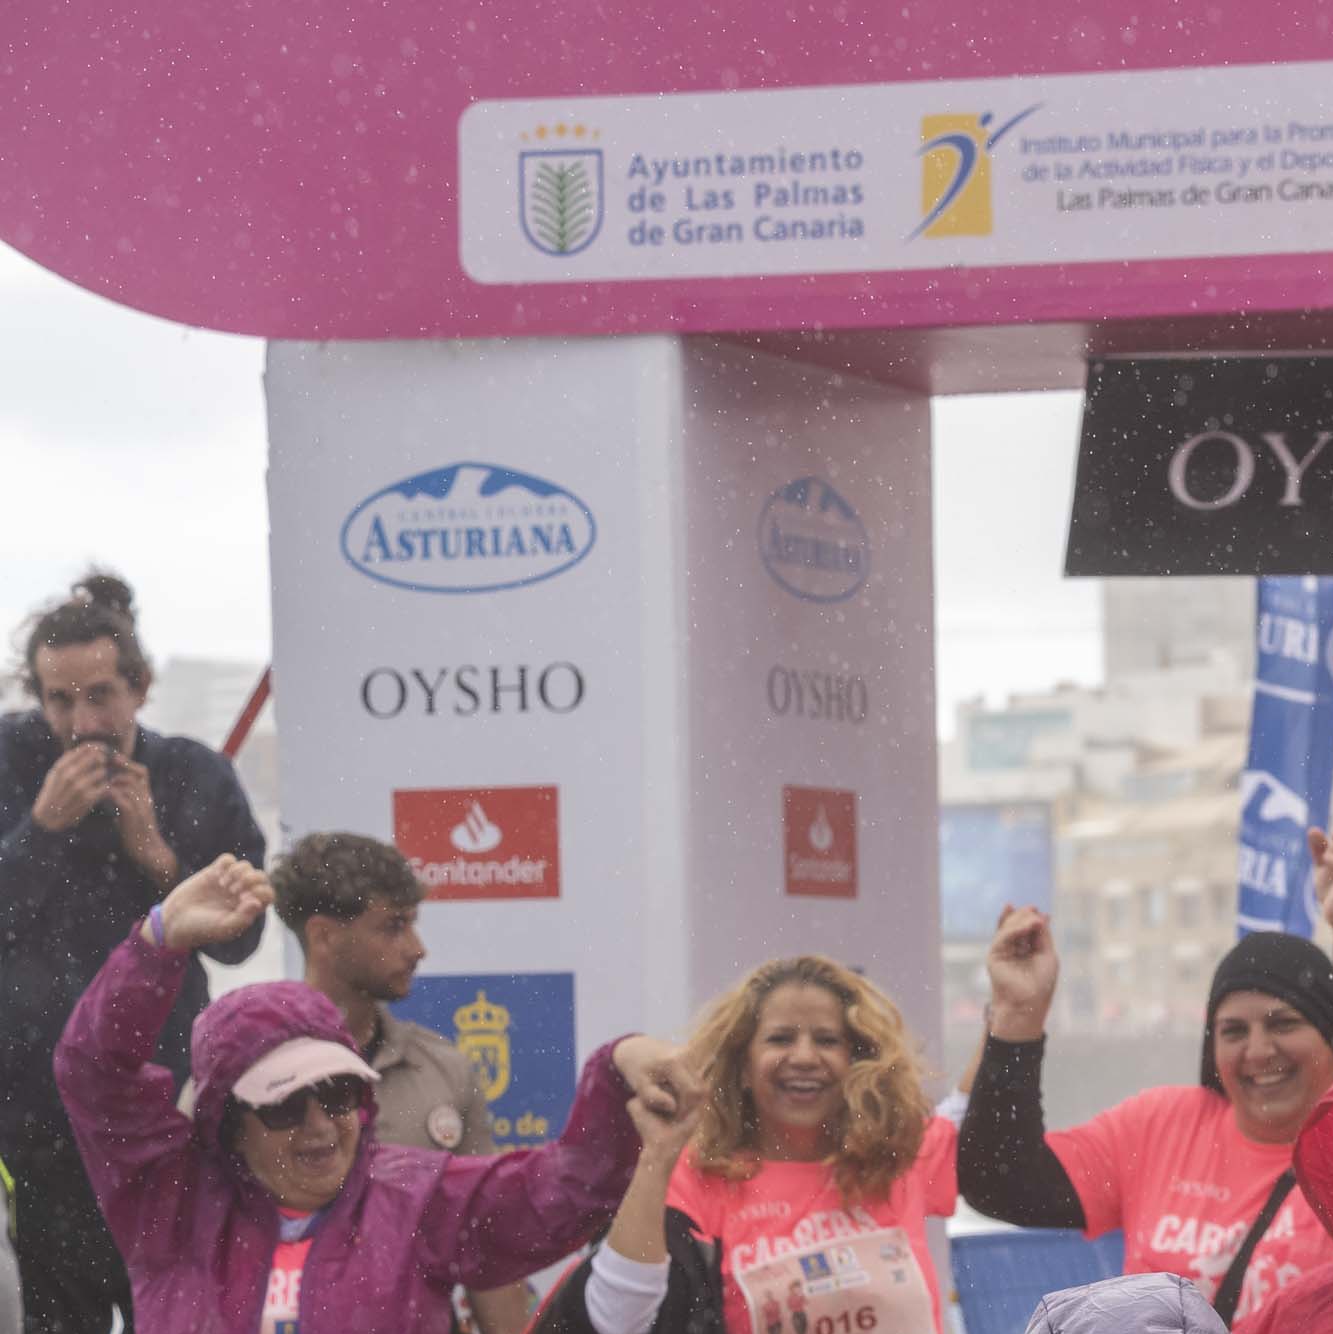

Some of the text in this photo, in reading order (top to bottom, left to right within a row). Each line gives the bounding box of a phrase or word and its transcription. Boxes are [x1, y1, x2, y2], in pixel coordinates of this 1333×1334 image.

[1211, 128, 1259, 149] para
[1264, 123, 1283, 144] la
[628, 147, 864, 184] Ayuntamiento
[1022, 163, 1048, 182] de
[1054, 160, 1073, 181] la
[1078, 155, 1173, 179] Actividad
[628, 180, 865, 213] de Las Palmas
[1057, 189, 1092, 212] Las
[1097, 186, 1176, 210] Palmas
[1181, 183, 1209, 206] de
[1214, 181, 1272, 205] Gran
[628, 214, 865, 246] de Gran Canaria
[363, 513, 576, 562] ASTURIANA
[360, 661, 585, 720] OYSHO
[767, 664, 869, 725] OYSHO
[409, 856, 547, 887] Santander
